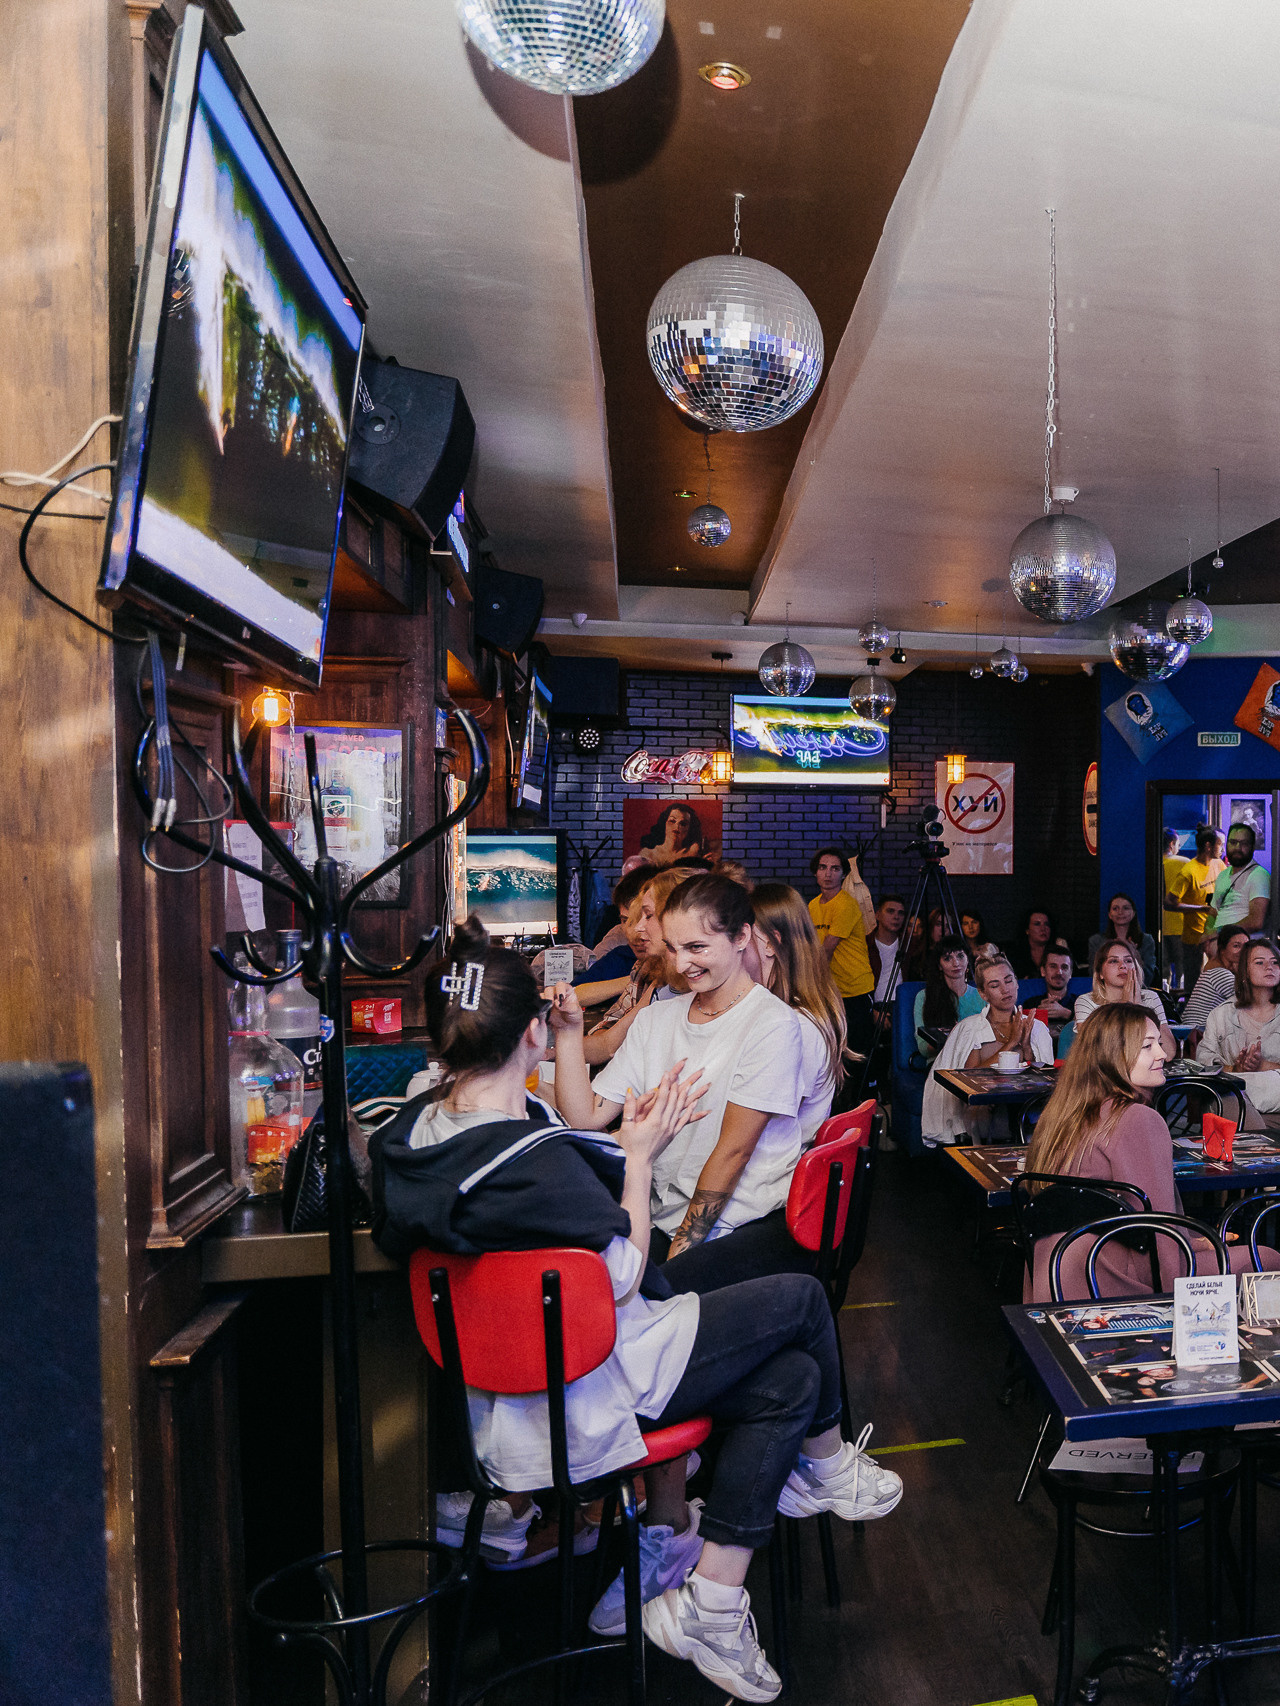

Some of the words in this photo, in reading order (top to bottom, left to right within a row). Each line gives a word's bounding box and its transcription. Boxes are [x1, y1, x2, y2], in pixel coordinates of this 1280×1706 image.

[1202, 734, 1238, 745] ВЫХОД
[952, 791, 998, 813] ХУЙ
[1186, 1281, 1206, 1290] СДЕЛАЙ
